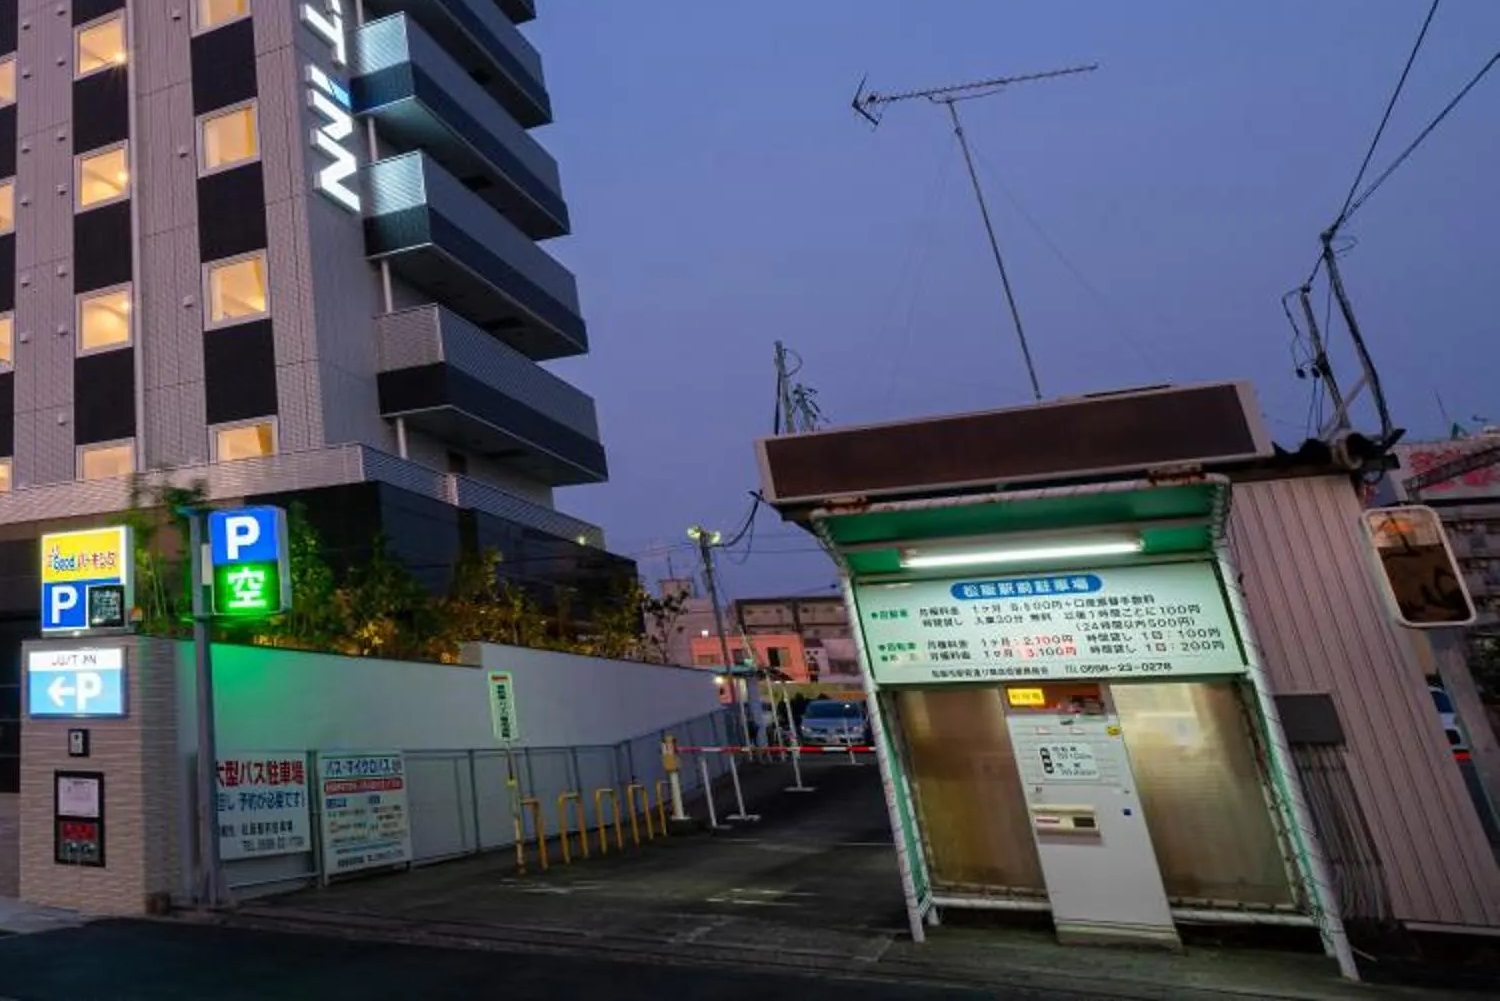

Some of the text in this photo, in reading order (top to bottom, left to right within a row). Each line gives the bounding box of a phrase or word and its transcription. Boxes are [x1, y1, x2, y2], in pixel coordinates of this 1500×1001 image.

[225, 516, 261, 560] P
[52, 586, 78, 624] P
[228, 567, 267, 609] 空
[77, 672, 102, 713] P
